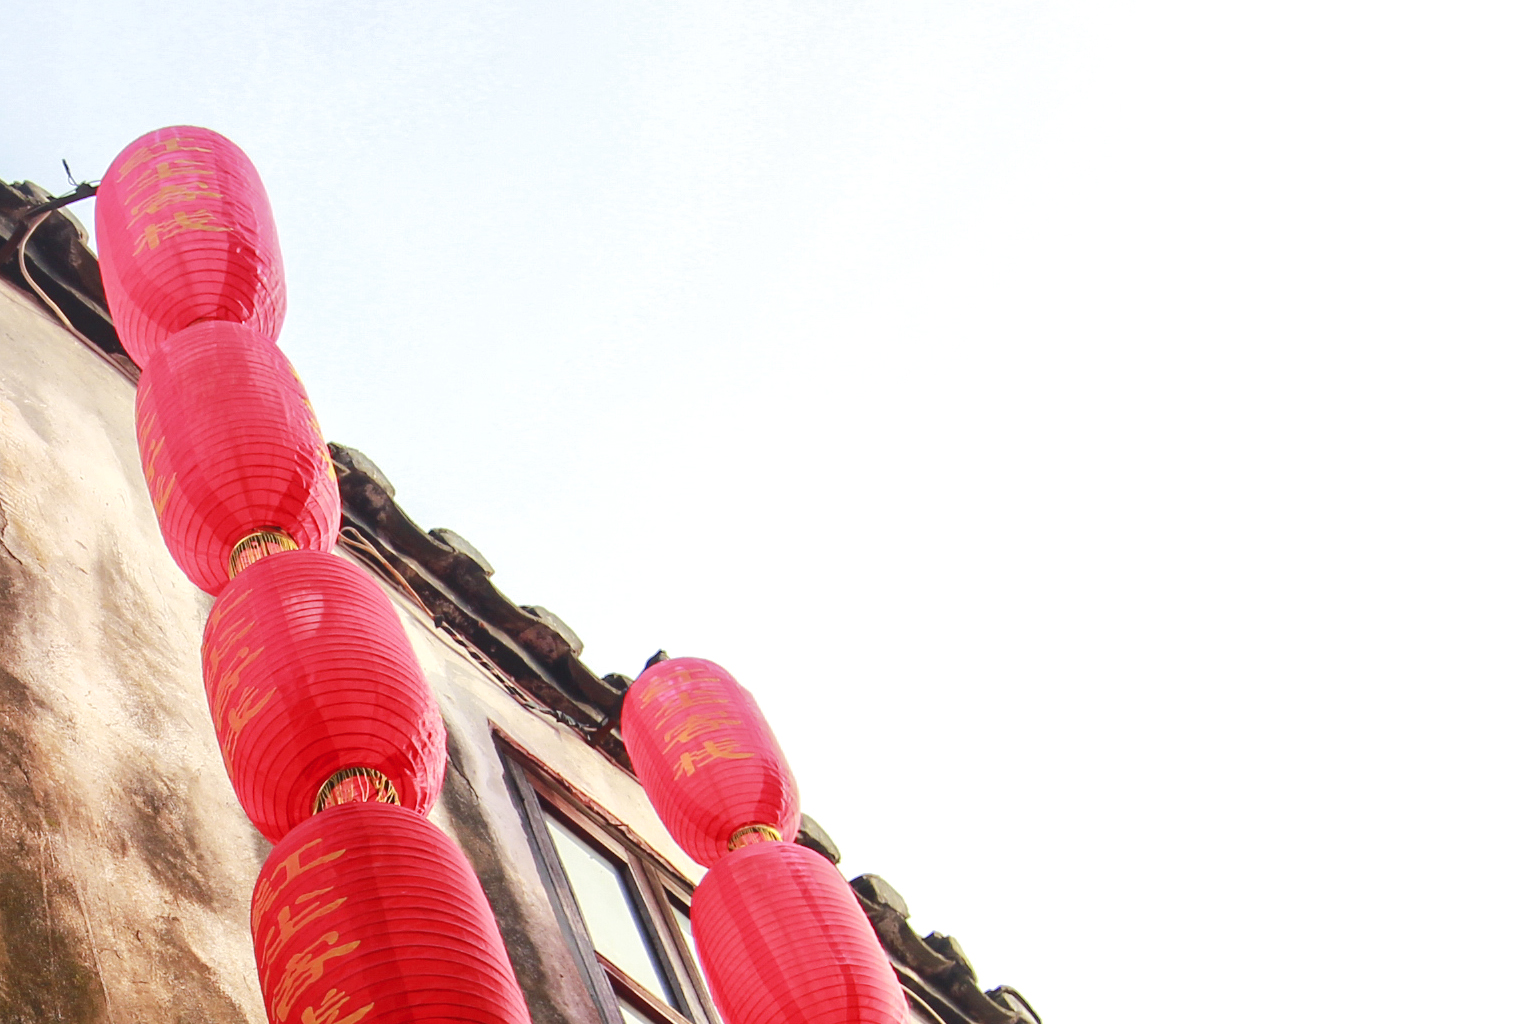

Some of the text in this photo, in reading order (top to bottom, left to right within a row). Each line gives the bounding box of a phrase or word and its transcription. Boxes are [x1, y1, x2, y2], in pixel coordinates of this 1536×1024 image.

[117, 137, 234, 257] 红尘客栈
[639, 669, 755, 781] 红尘客栈
